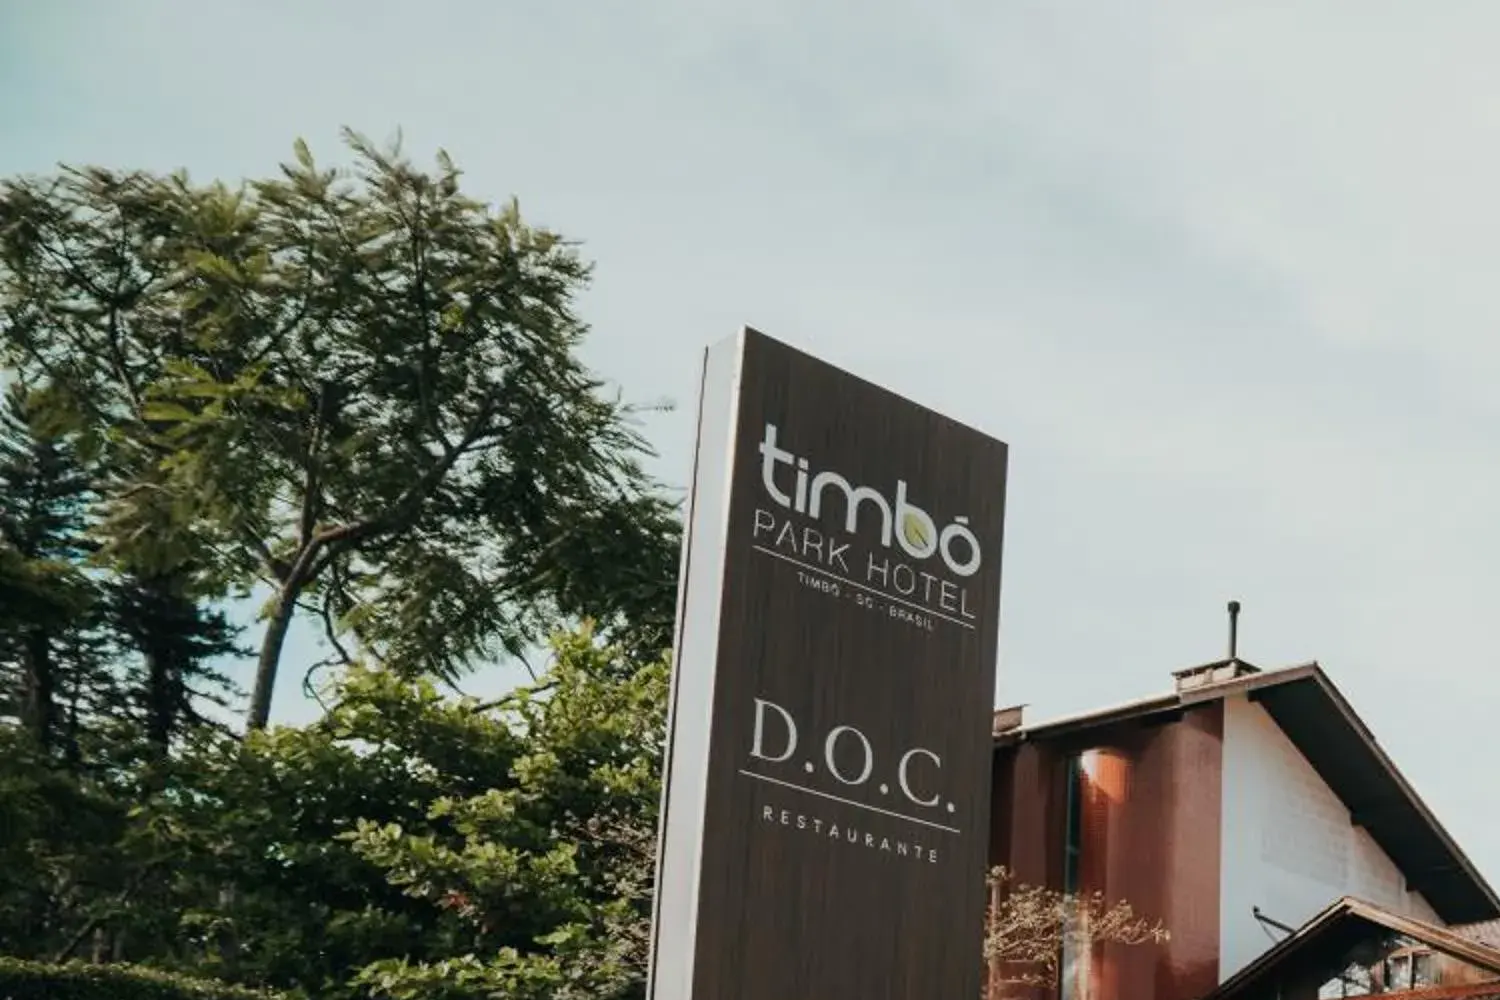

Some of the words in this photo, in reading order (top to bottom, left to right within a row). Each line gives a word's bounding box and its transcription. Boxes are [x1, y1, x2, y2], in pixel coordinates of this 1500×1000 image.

[753, 508, 850, 574] PARK
[866, 551, 977, 620] HOTEL
[888, 605, 935, 631] BRASIL
[749, 697, 956, 814] D.O.C.
[763, 805, 938, 864] RESTAURANTE
